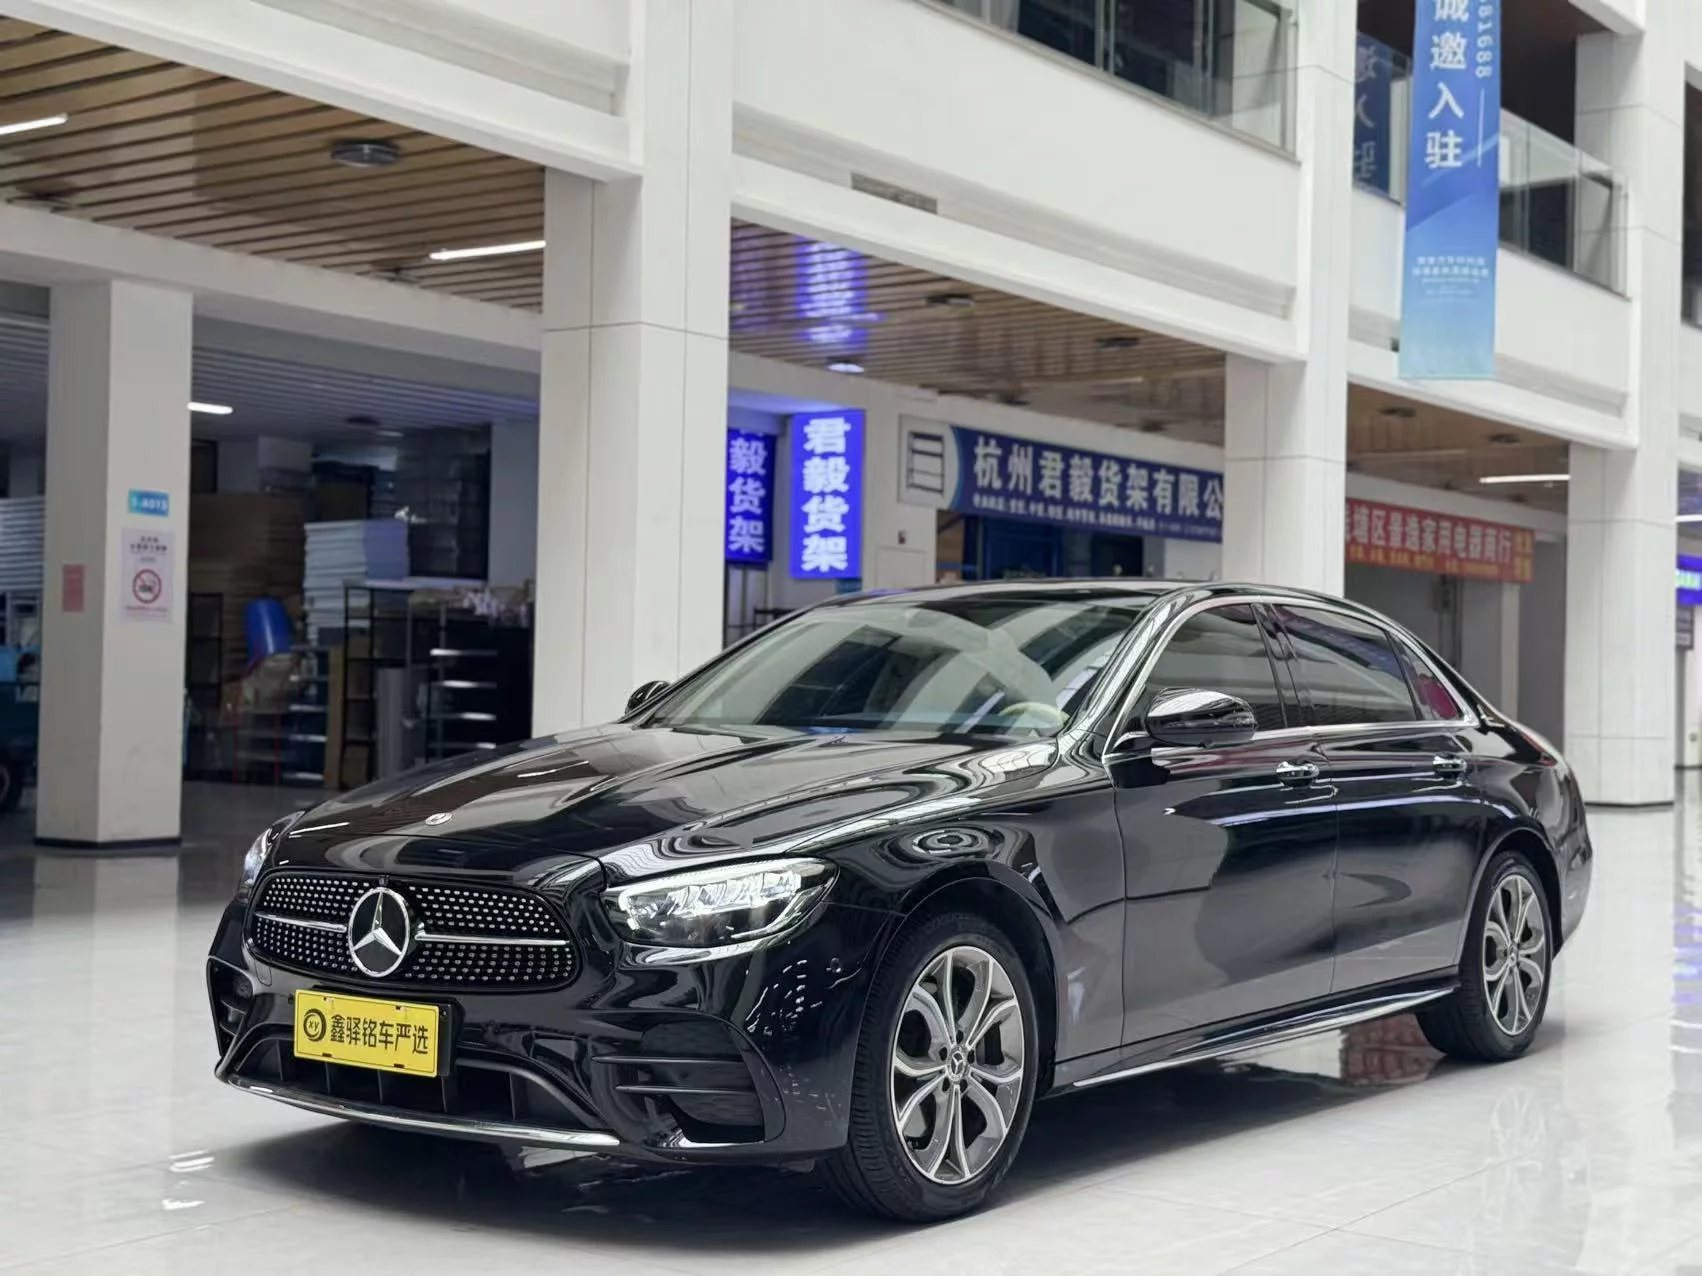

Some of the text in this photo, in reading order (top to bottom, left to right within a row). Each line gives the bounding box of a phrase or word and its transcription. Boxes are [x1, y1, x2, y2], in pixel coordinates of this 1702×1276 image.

[1475, 0, 1494, 78] 81688
[728, 430, 768, 554] 毅货架
[801, 417, 851, 573] 君毅货架
[973, 436, 1223, 520] 杭州君毅货架有限公
[330, 1014, 430, 1055] 鑫驿铭车严选
